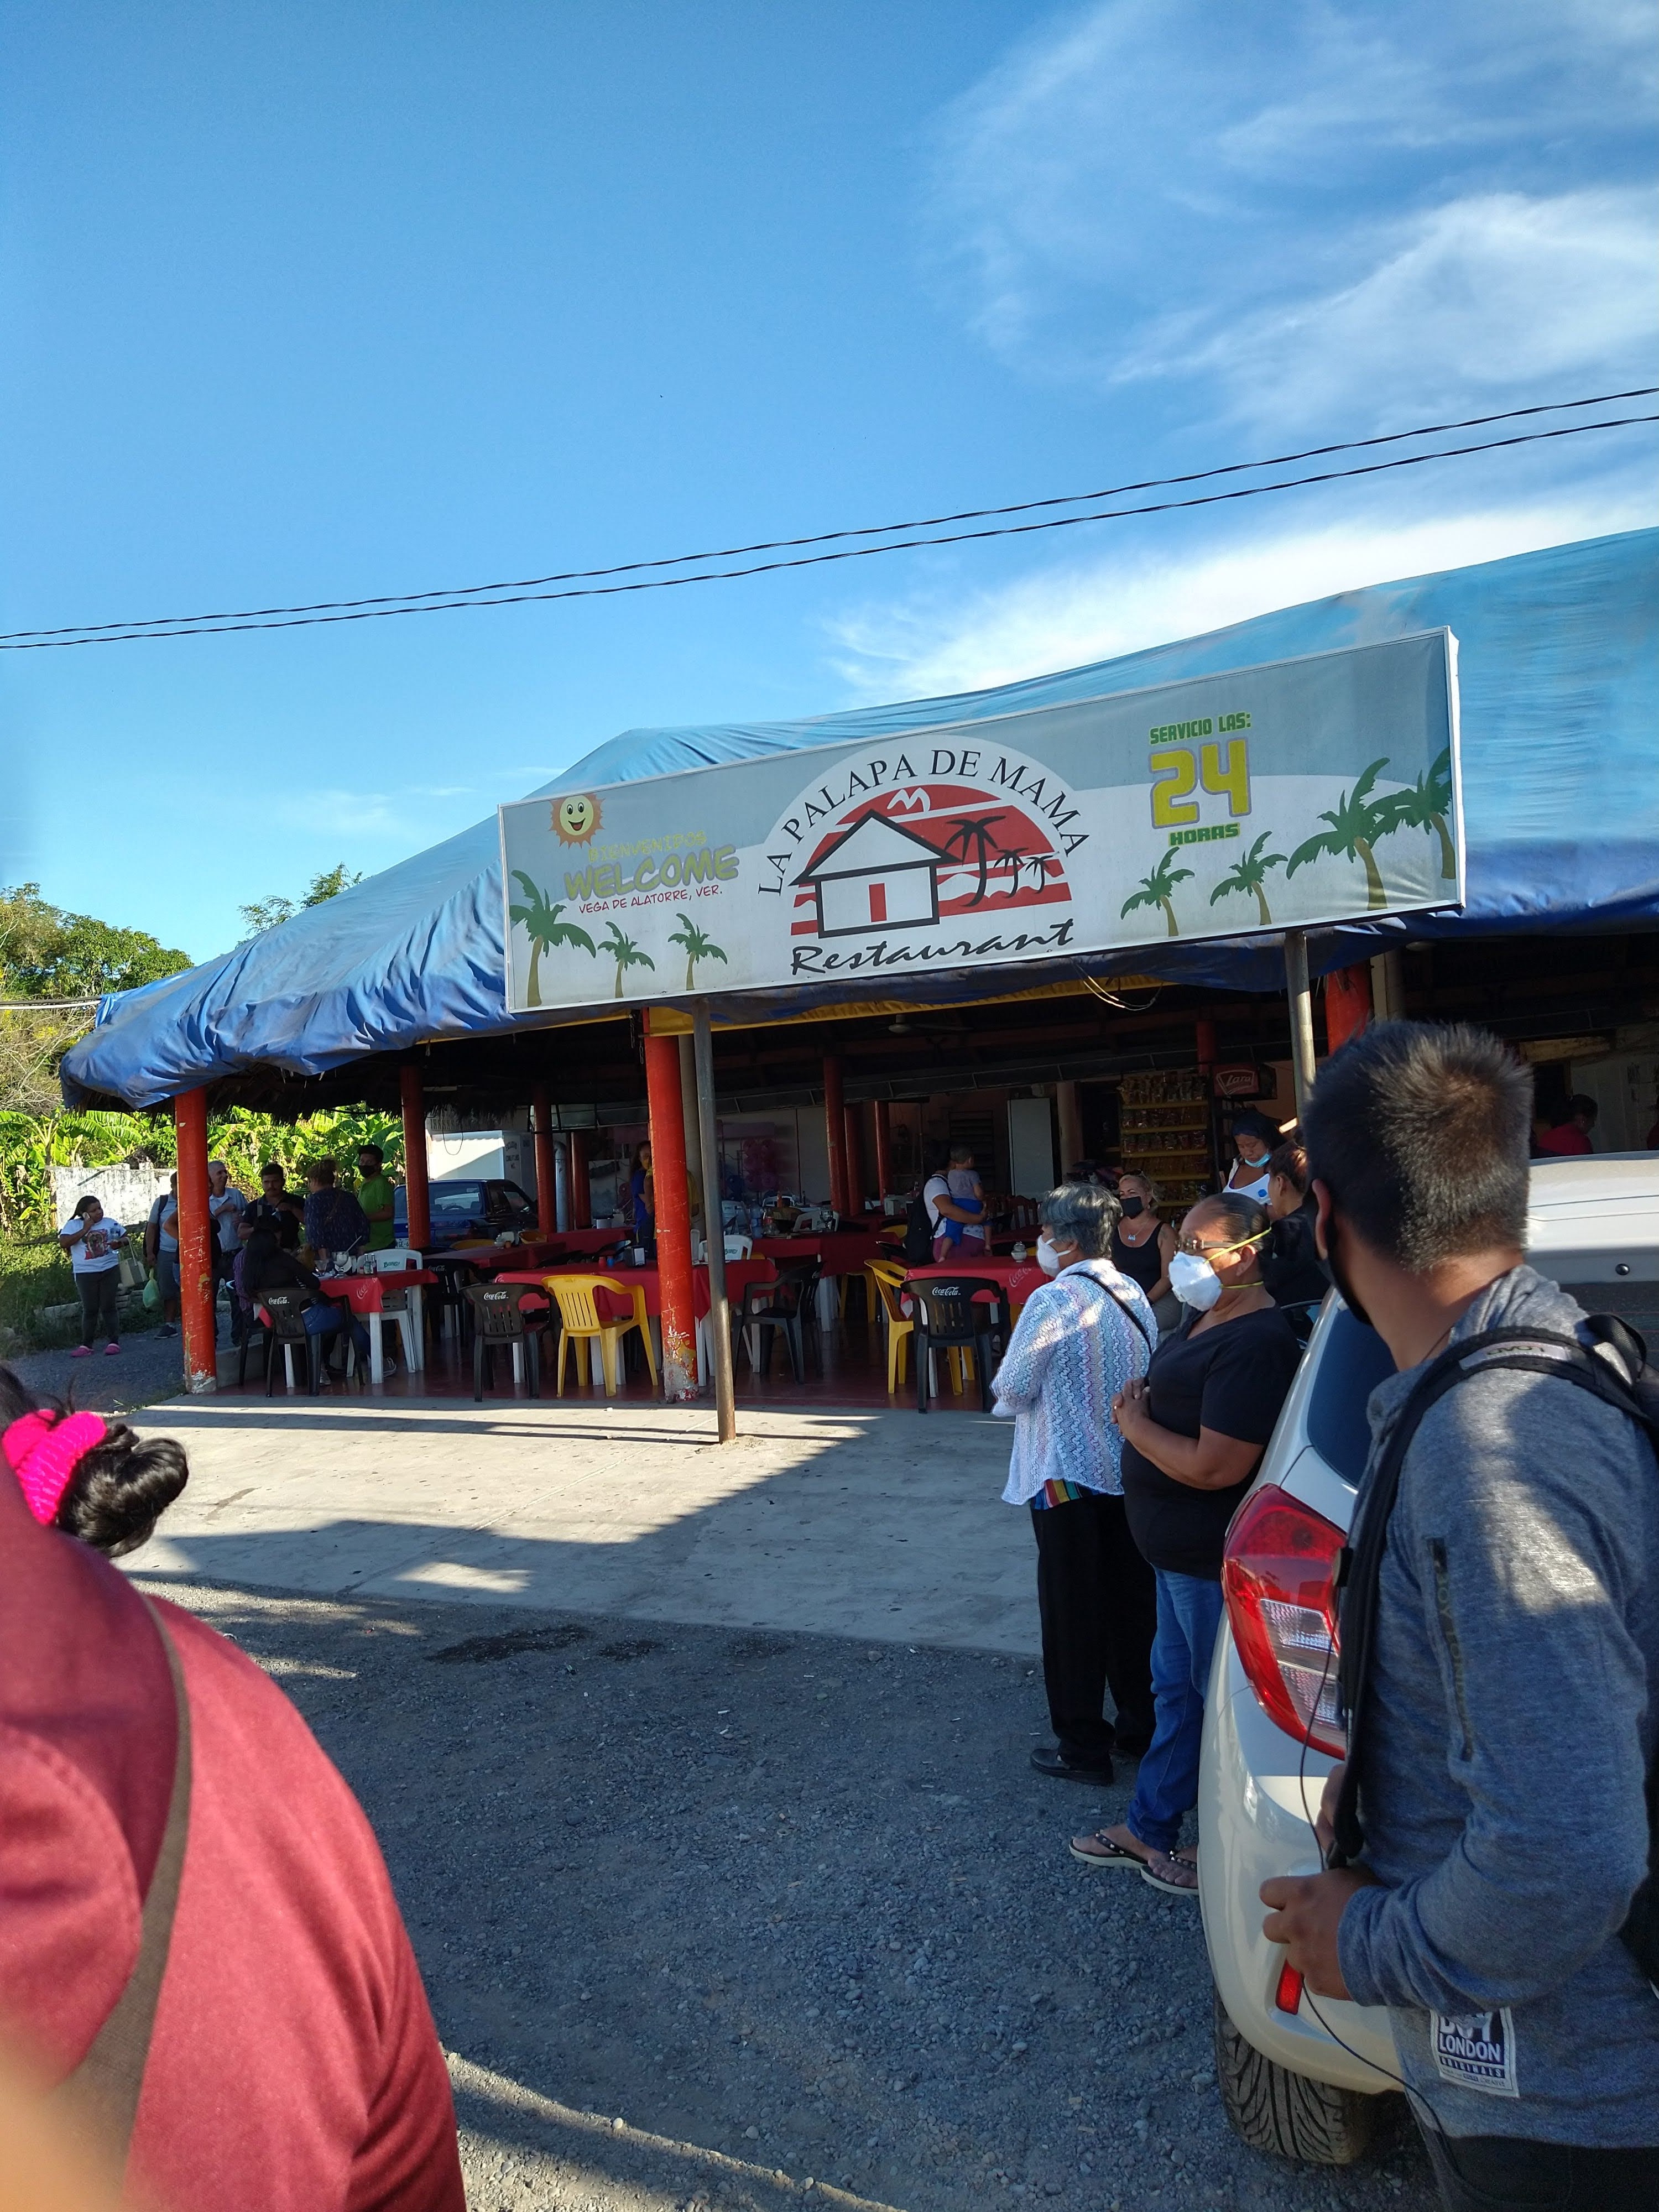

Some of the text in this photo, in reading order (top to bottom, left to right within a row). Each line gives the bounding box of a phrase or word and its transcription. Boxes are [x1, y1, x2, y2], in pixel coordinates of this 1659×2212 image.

[1150, 712, 1251, 745] SERVICIO LAS:
[1149, 737, 1251, 829] 24
[758, 749, 1091, 896] LA PALAPA DE MAMA
[1168, 822, 1240, 847] HORAS
[588, 830, 707, 863] BIENVENIDOS
[564, 844, 740, 901] WELCOME
[578, 884, 723, 914] VEGA DE ALATORRE, VER.
[790, 918, 1074, 975] Restaurant
[1439, 2033, 1501, 2063] LONDON
